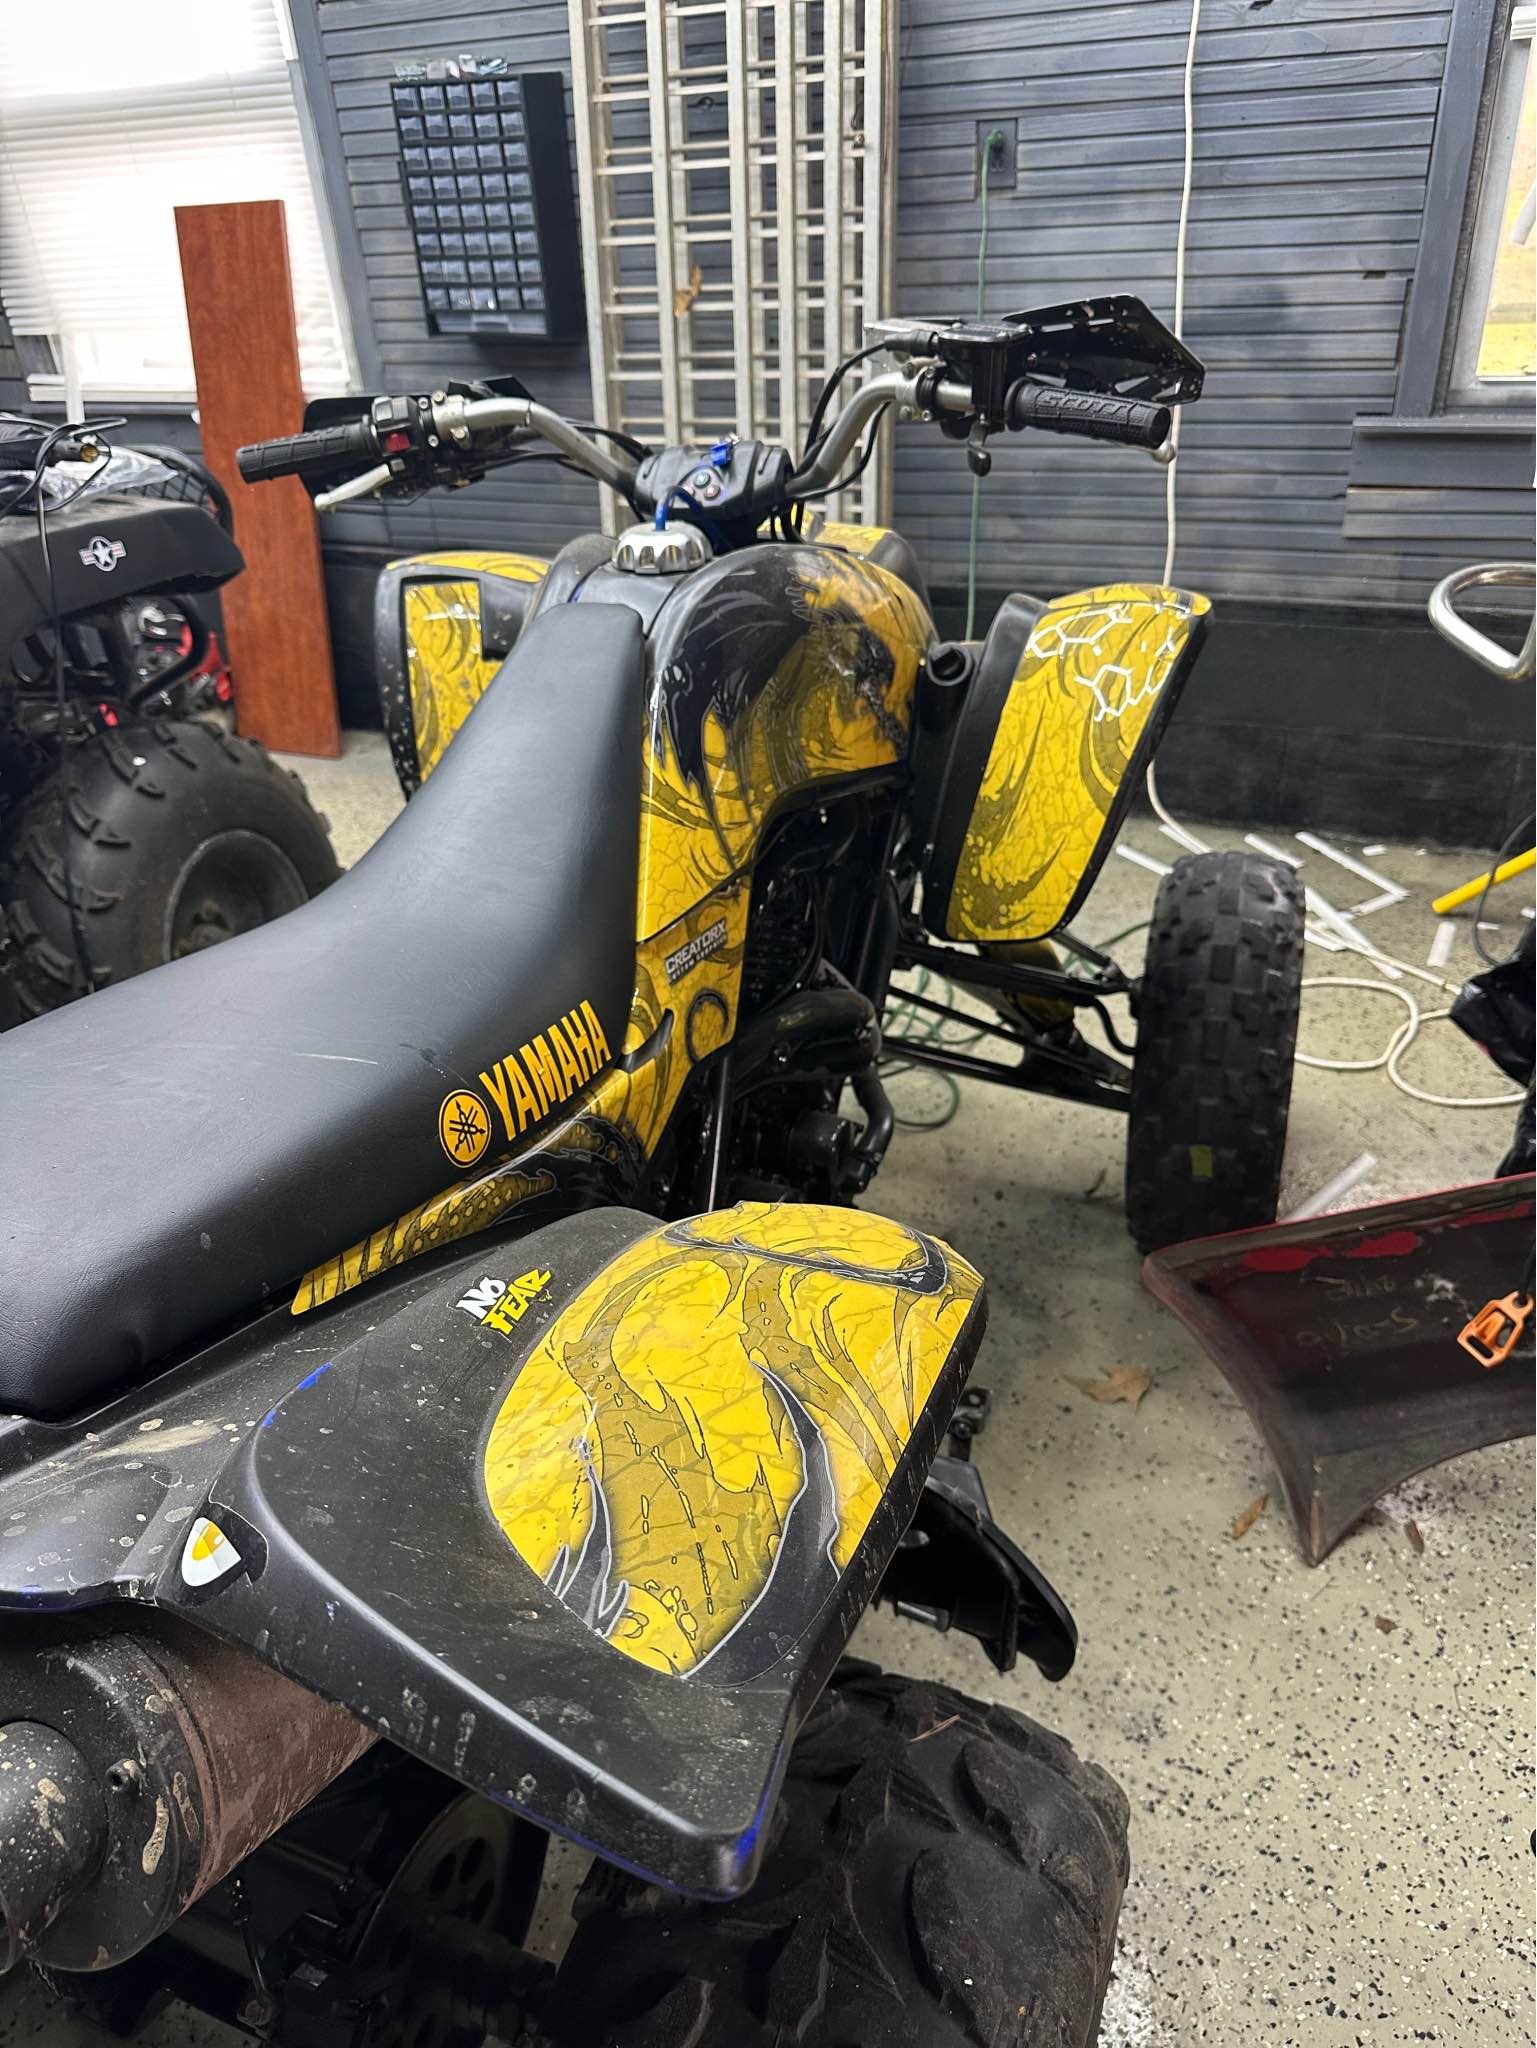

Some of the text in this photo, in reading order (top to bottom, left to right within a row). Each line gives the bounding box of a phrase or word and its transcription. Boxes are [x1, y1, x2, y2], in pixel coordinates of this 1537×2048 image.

[1037, 391, 1129, 415] SCOTT
[665, 919, 726, 974] CREATORX
[478, 999, 612, 1142] YAMAHA
[480, 1268, 552, 1335] FEAR
